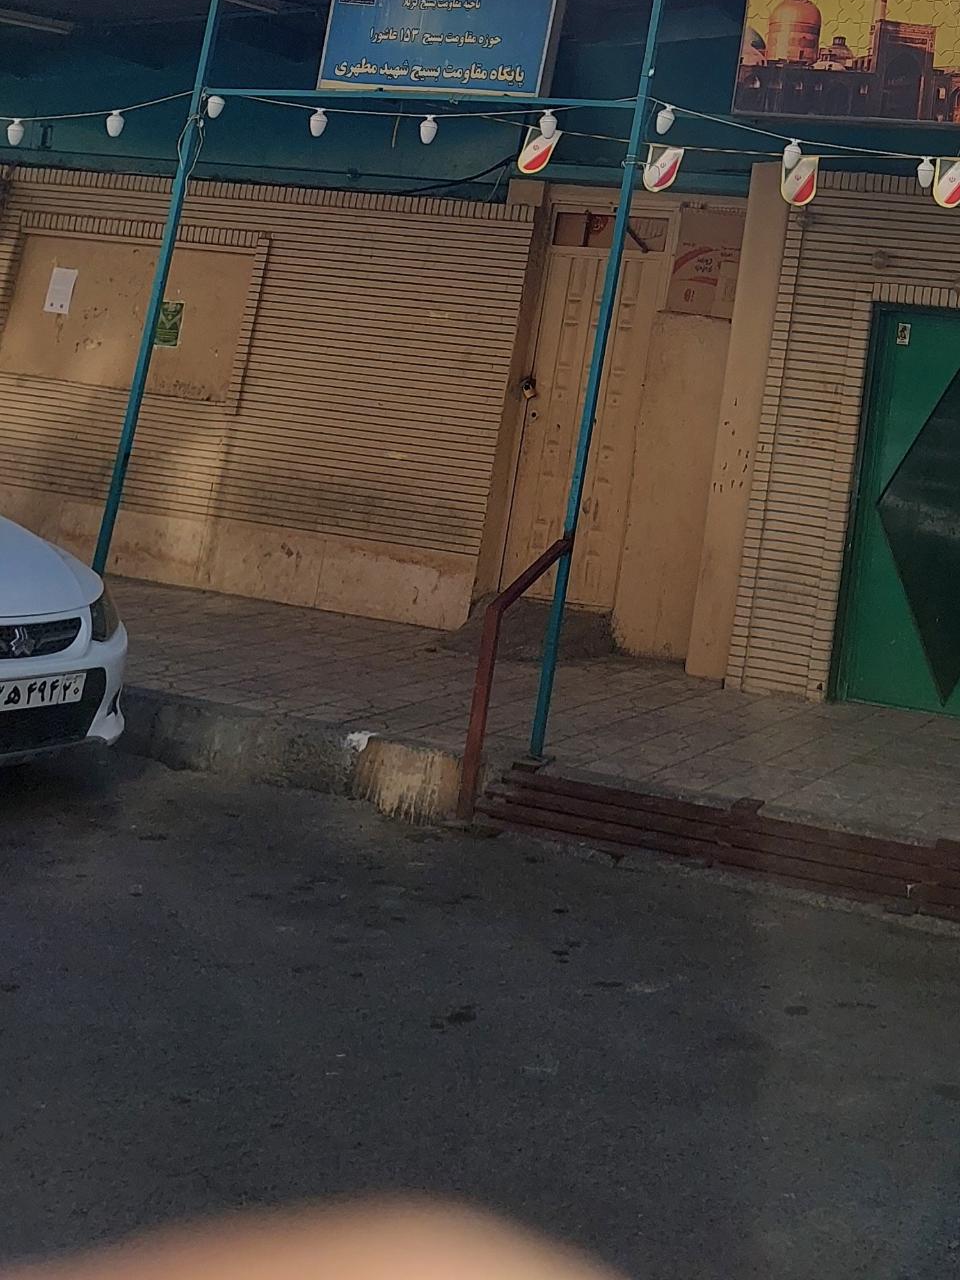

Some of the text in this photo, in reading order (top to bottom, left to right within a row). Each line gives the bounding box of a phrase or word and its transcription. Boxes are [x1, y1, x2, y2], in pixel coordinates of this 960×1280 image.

[420, 0, 437, 10] بسیج
[370, 26, 502, 48] حوزه مقاومت بسیج ۱۵۳ عاشورا
[334, 56, 525, 88] پایگاه مقاومت بسیج شهید مطهری
